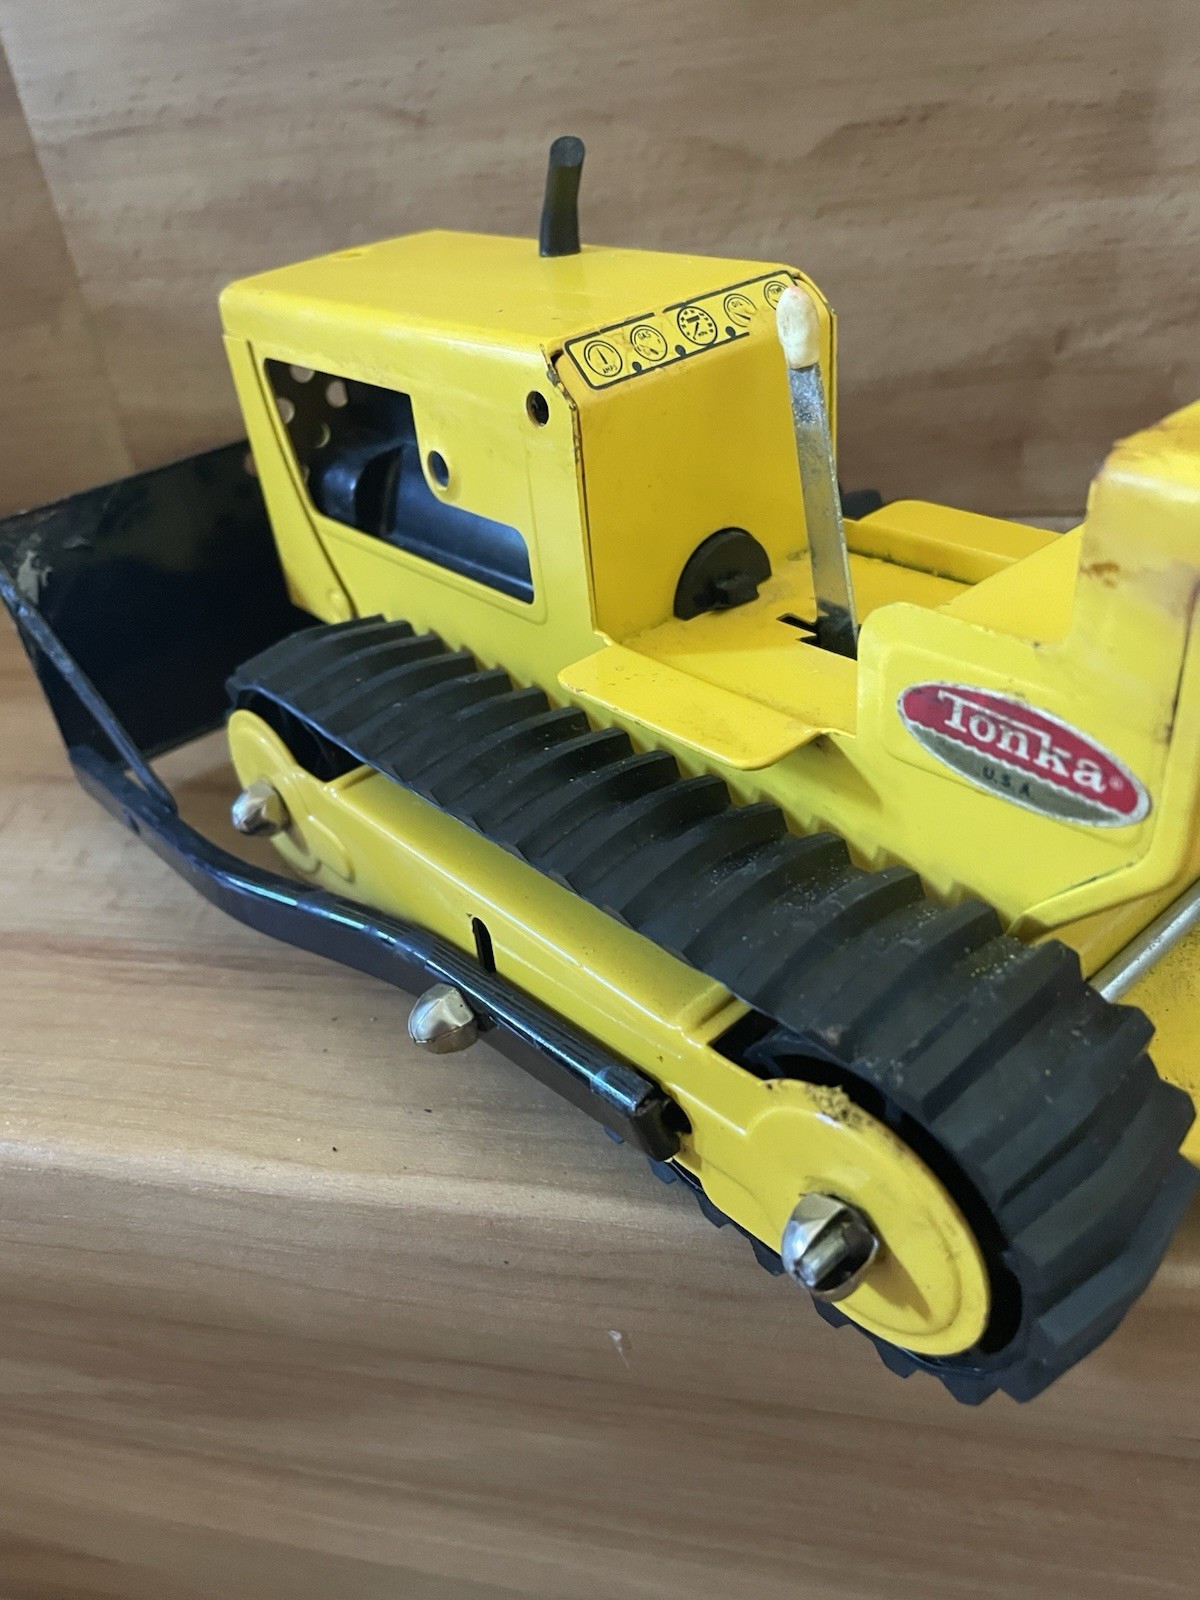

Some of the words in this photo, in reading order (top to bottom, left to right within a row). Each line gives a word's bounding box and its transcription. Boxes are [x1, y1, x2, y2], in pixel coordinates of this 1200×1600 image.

[731, 300, 743, 308] OIL
[637, 330, 651, 340] GAS
[602, 363, 618, 374] AMPS
[937, 689, 1107, 794] Tonka
[982, 765, 1030, 798] U.SA
